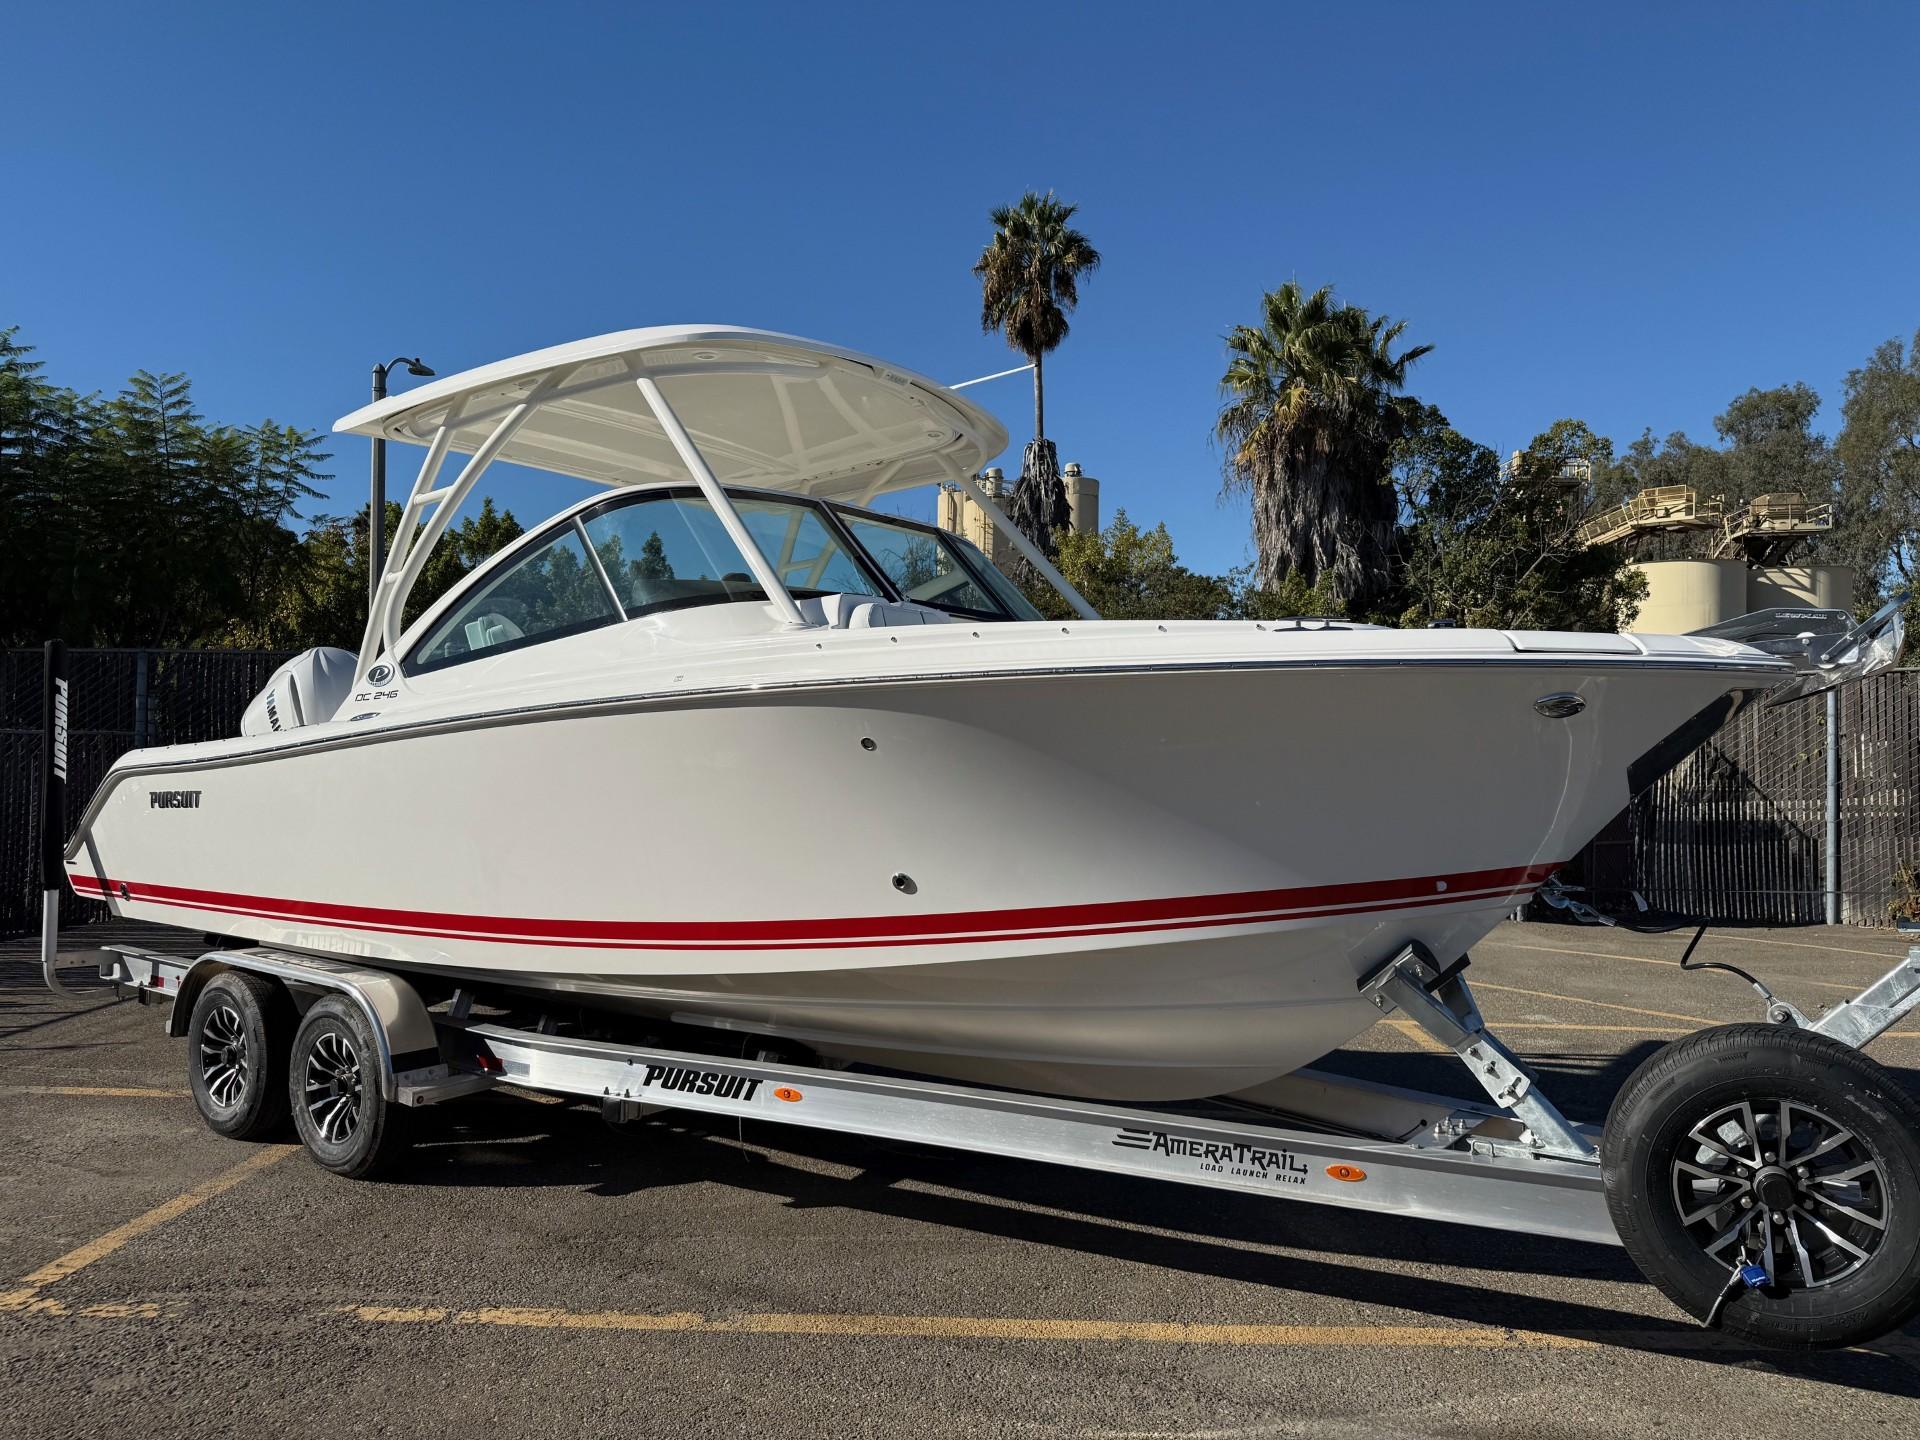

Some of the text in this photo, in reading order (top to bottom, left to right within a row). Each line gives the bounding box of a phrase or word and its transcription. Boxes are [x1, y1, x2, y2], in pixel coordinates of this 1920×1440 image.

[373, 689, 399, 700] 246
[54, 677, 68, 784] PURSUIT
[149, 790, 202, 809] PURSUIT
[642, 1064, 764, 1102] PURSUIT
[1200, 1162, 1307, 1185] LOAD LAUNCH RELAX
